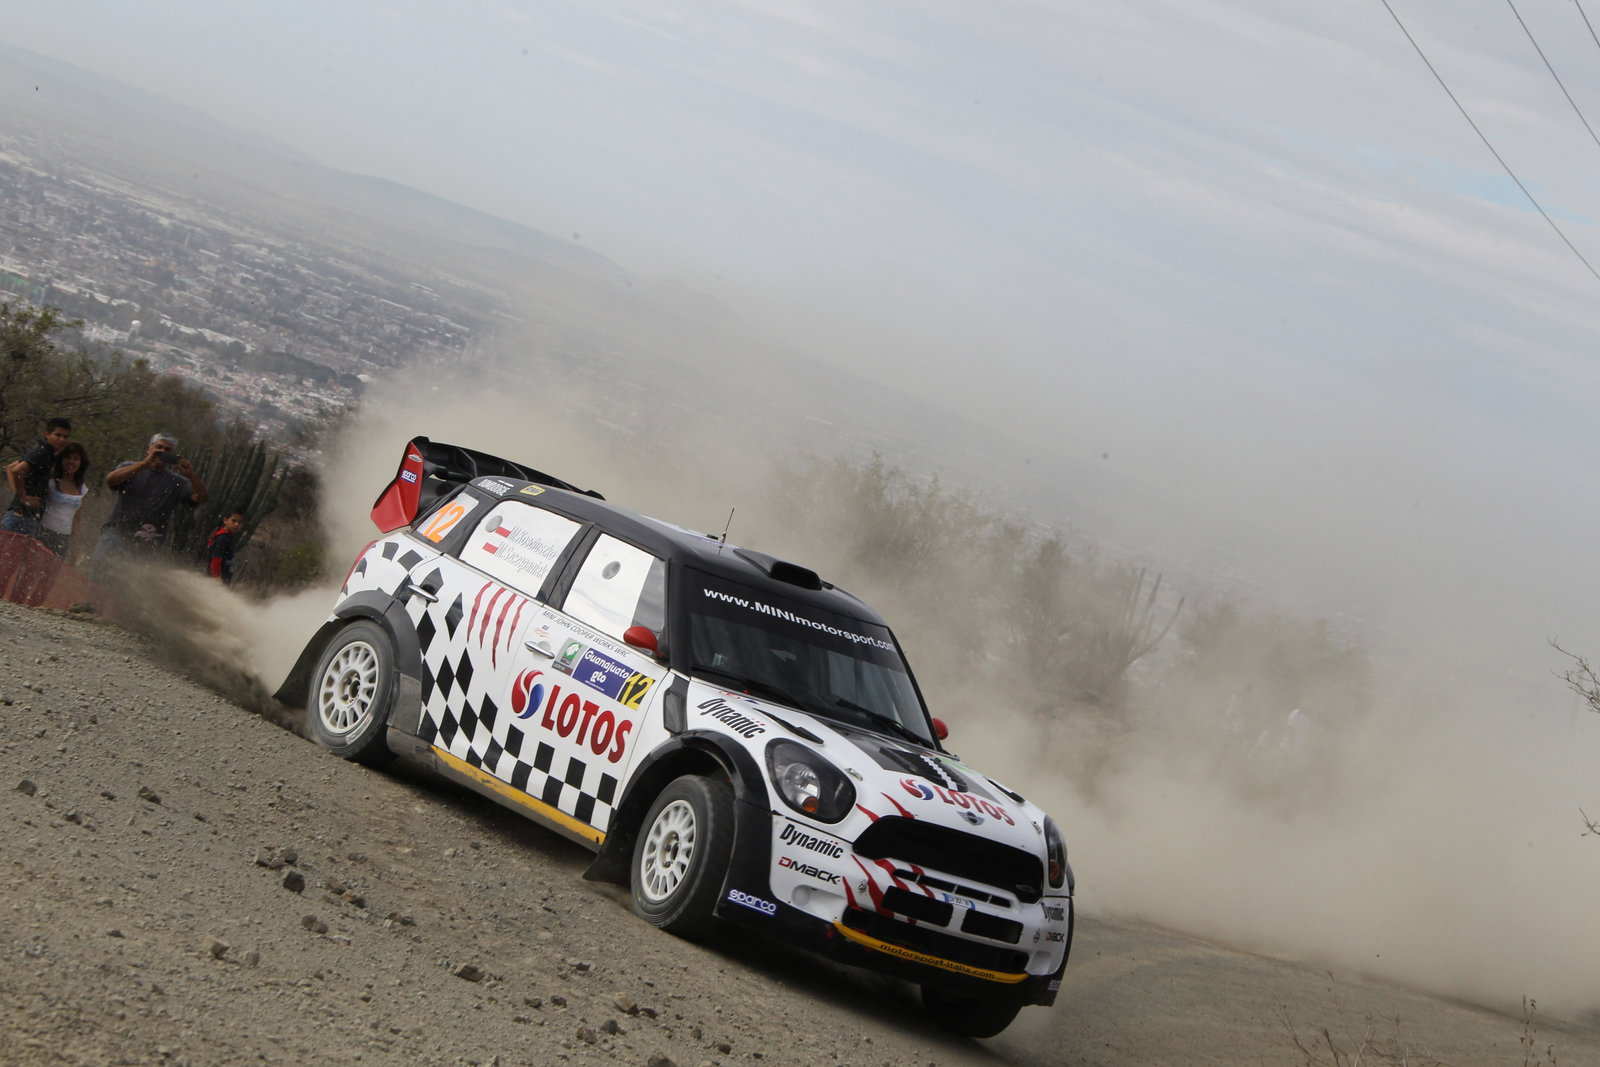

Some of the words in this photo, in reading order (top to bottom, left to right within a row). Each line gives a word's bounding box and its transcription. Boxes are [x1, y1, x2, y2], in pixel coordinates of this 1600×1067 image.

[422, 502, 465, 543] 12
[543, 610, 555, 621] MINI
[555, 618, 572, 629] JOHN
[571, 624, 595, 641] COOPER
[593, 637, 615, 651] WORKS
[614, 648, 631, 658] WRC
[584, 650, 630, 678] Guanajuato
[590, 670, 607, 683] gto
[625, 673, 655, 711] 12
[541, 685, 633, 763] LOTOS
[697, 698, 766, 738] Dynamic
[933, 785, 1015, 826] LOTOS
[779, 823, 844, 859] Dynamic
[729, 889, 777, 913] sparco
